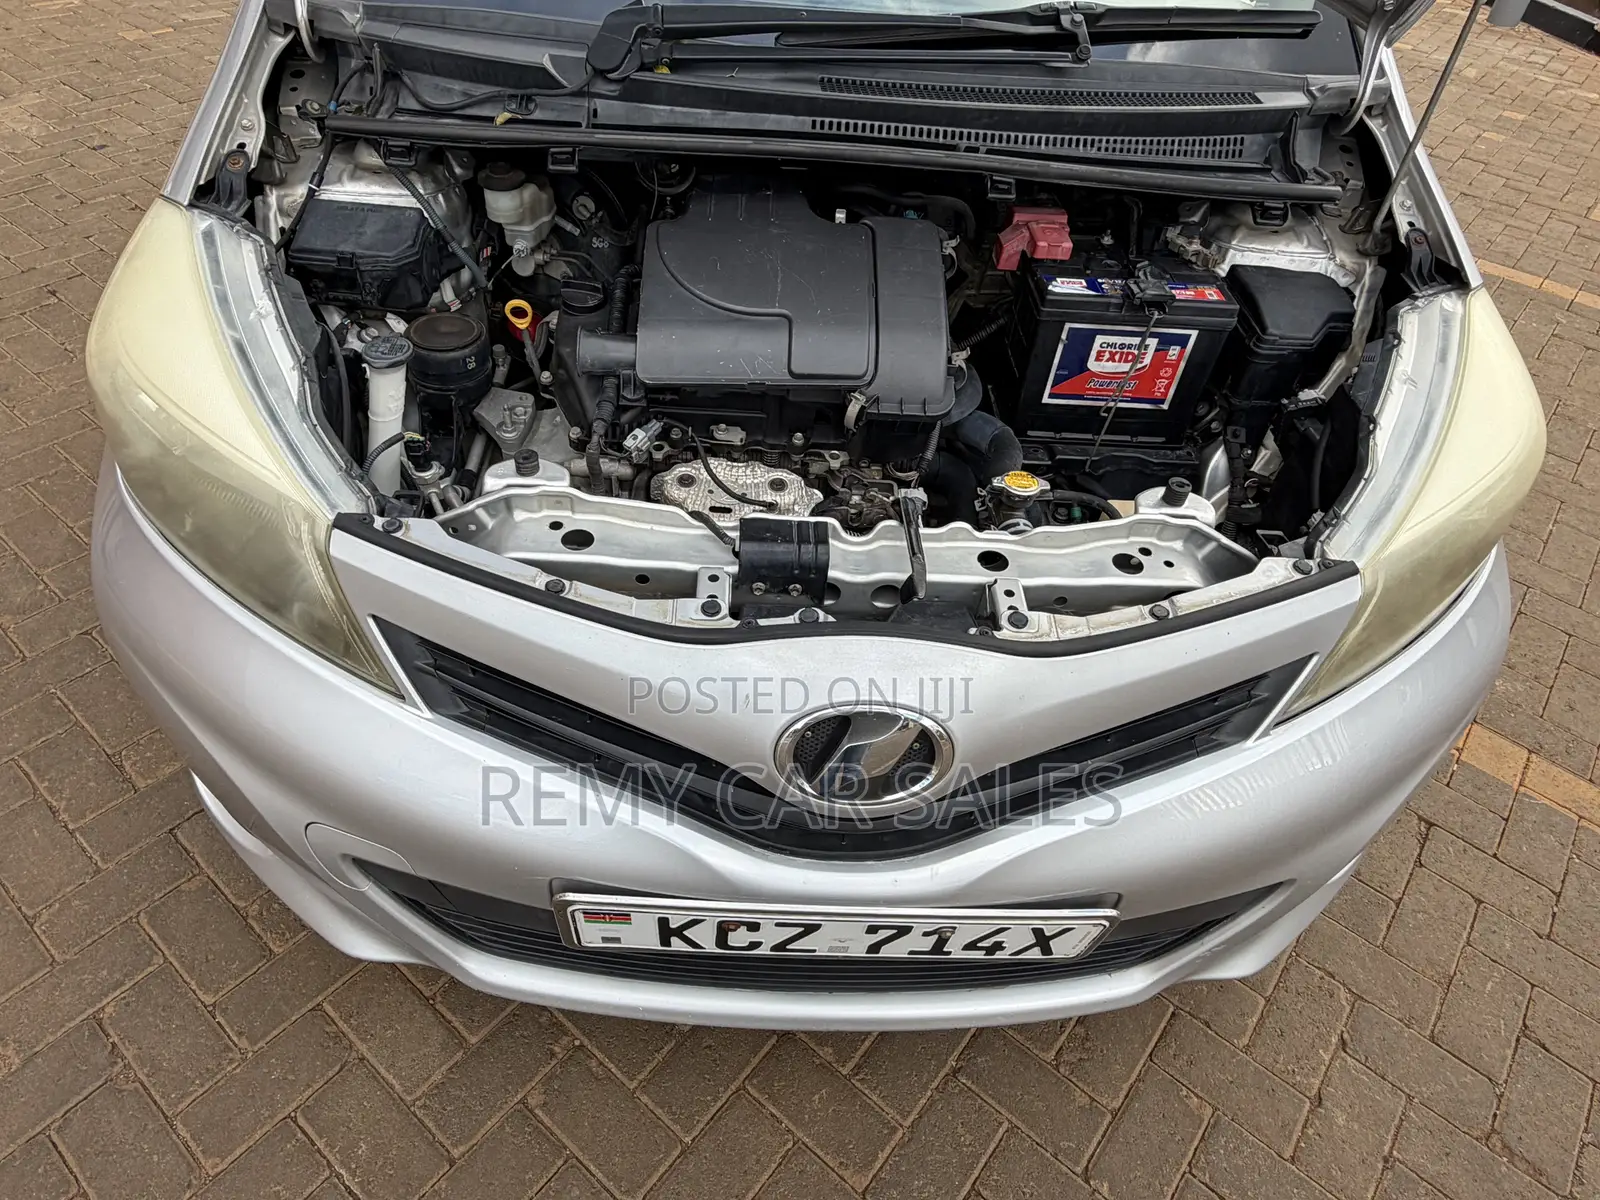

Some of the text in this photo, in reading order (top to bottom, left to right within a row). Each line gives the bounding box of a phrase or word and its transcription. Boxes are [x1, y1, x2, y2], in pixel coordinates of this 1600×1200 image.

[465, 356, 476, 370] 28
[1094, 350, 1149, 364] EXIDE
[656, 915, 824, 953] KCZ
[864, 924, 1077, 957] 714X
